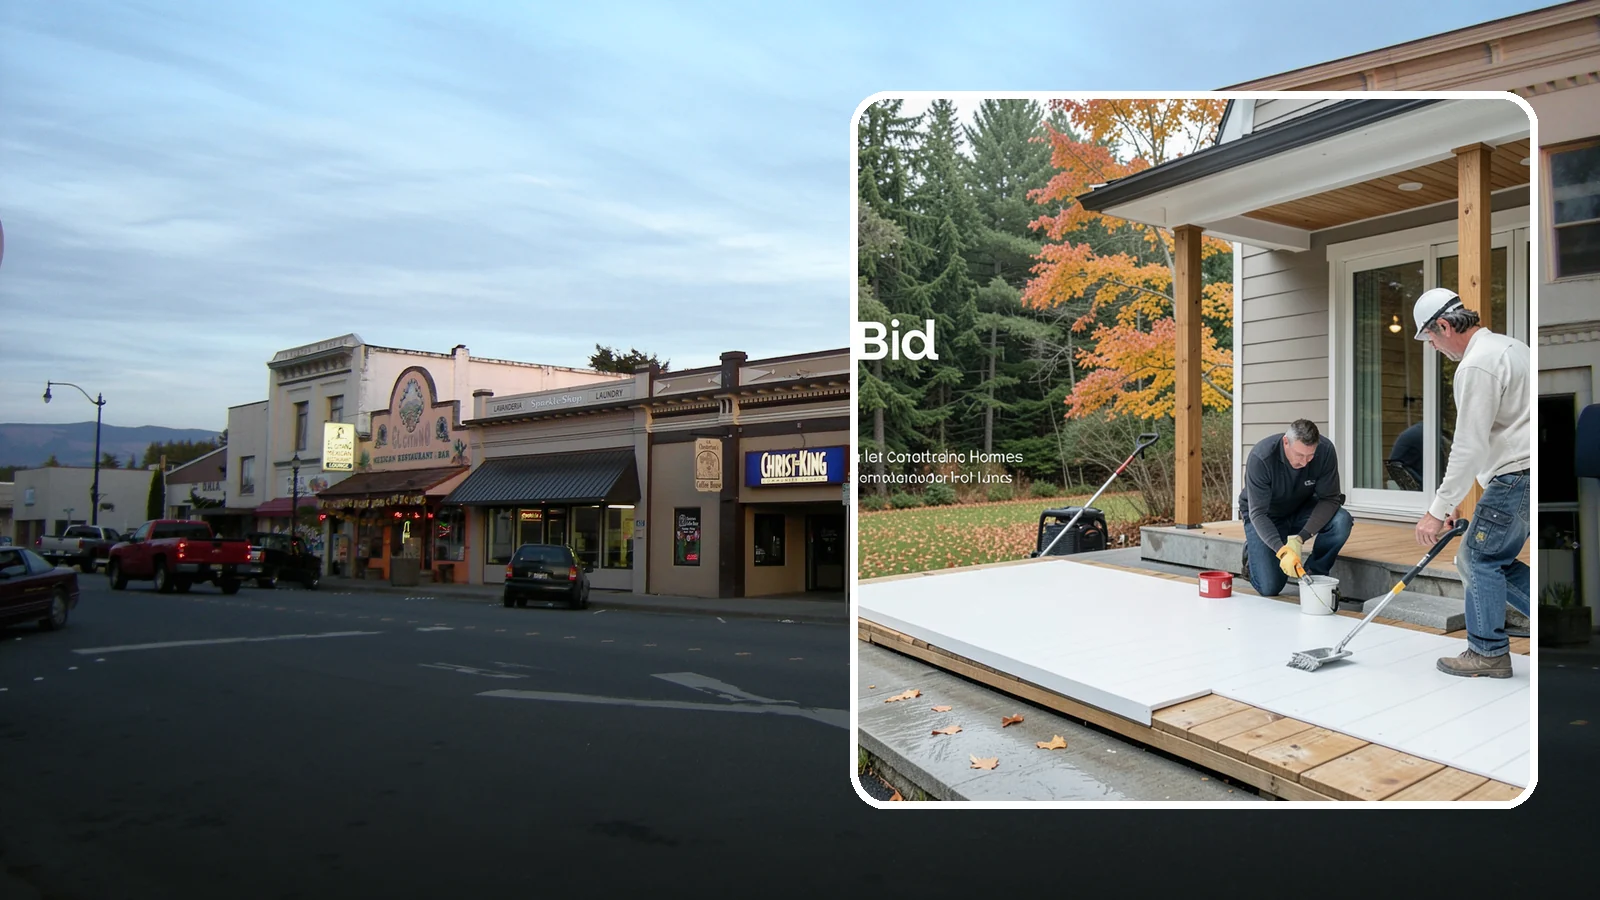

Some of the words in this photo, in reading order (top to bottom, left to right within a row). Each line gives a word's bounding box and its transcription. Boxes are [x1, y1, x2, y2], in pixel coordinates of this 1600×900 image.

[493, 401, 523, 413] LAVANDERIA
[531, 396, 560, 409] Sparkle
[562, 394, 582, 405] Shop
[595, 389, 624, 400] LAUNDRY
[374, 455, 395, 464] MEXICAN
[397, 451, 433, 462] RESTAURANT
[438, 450, 450, 459] BAR
